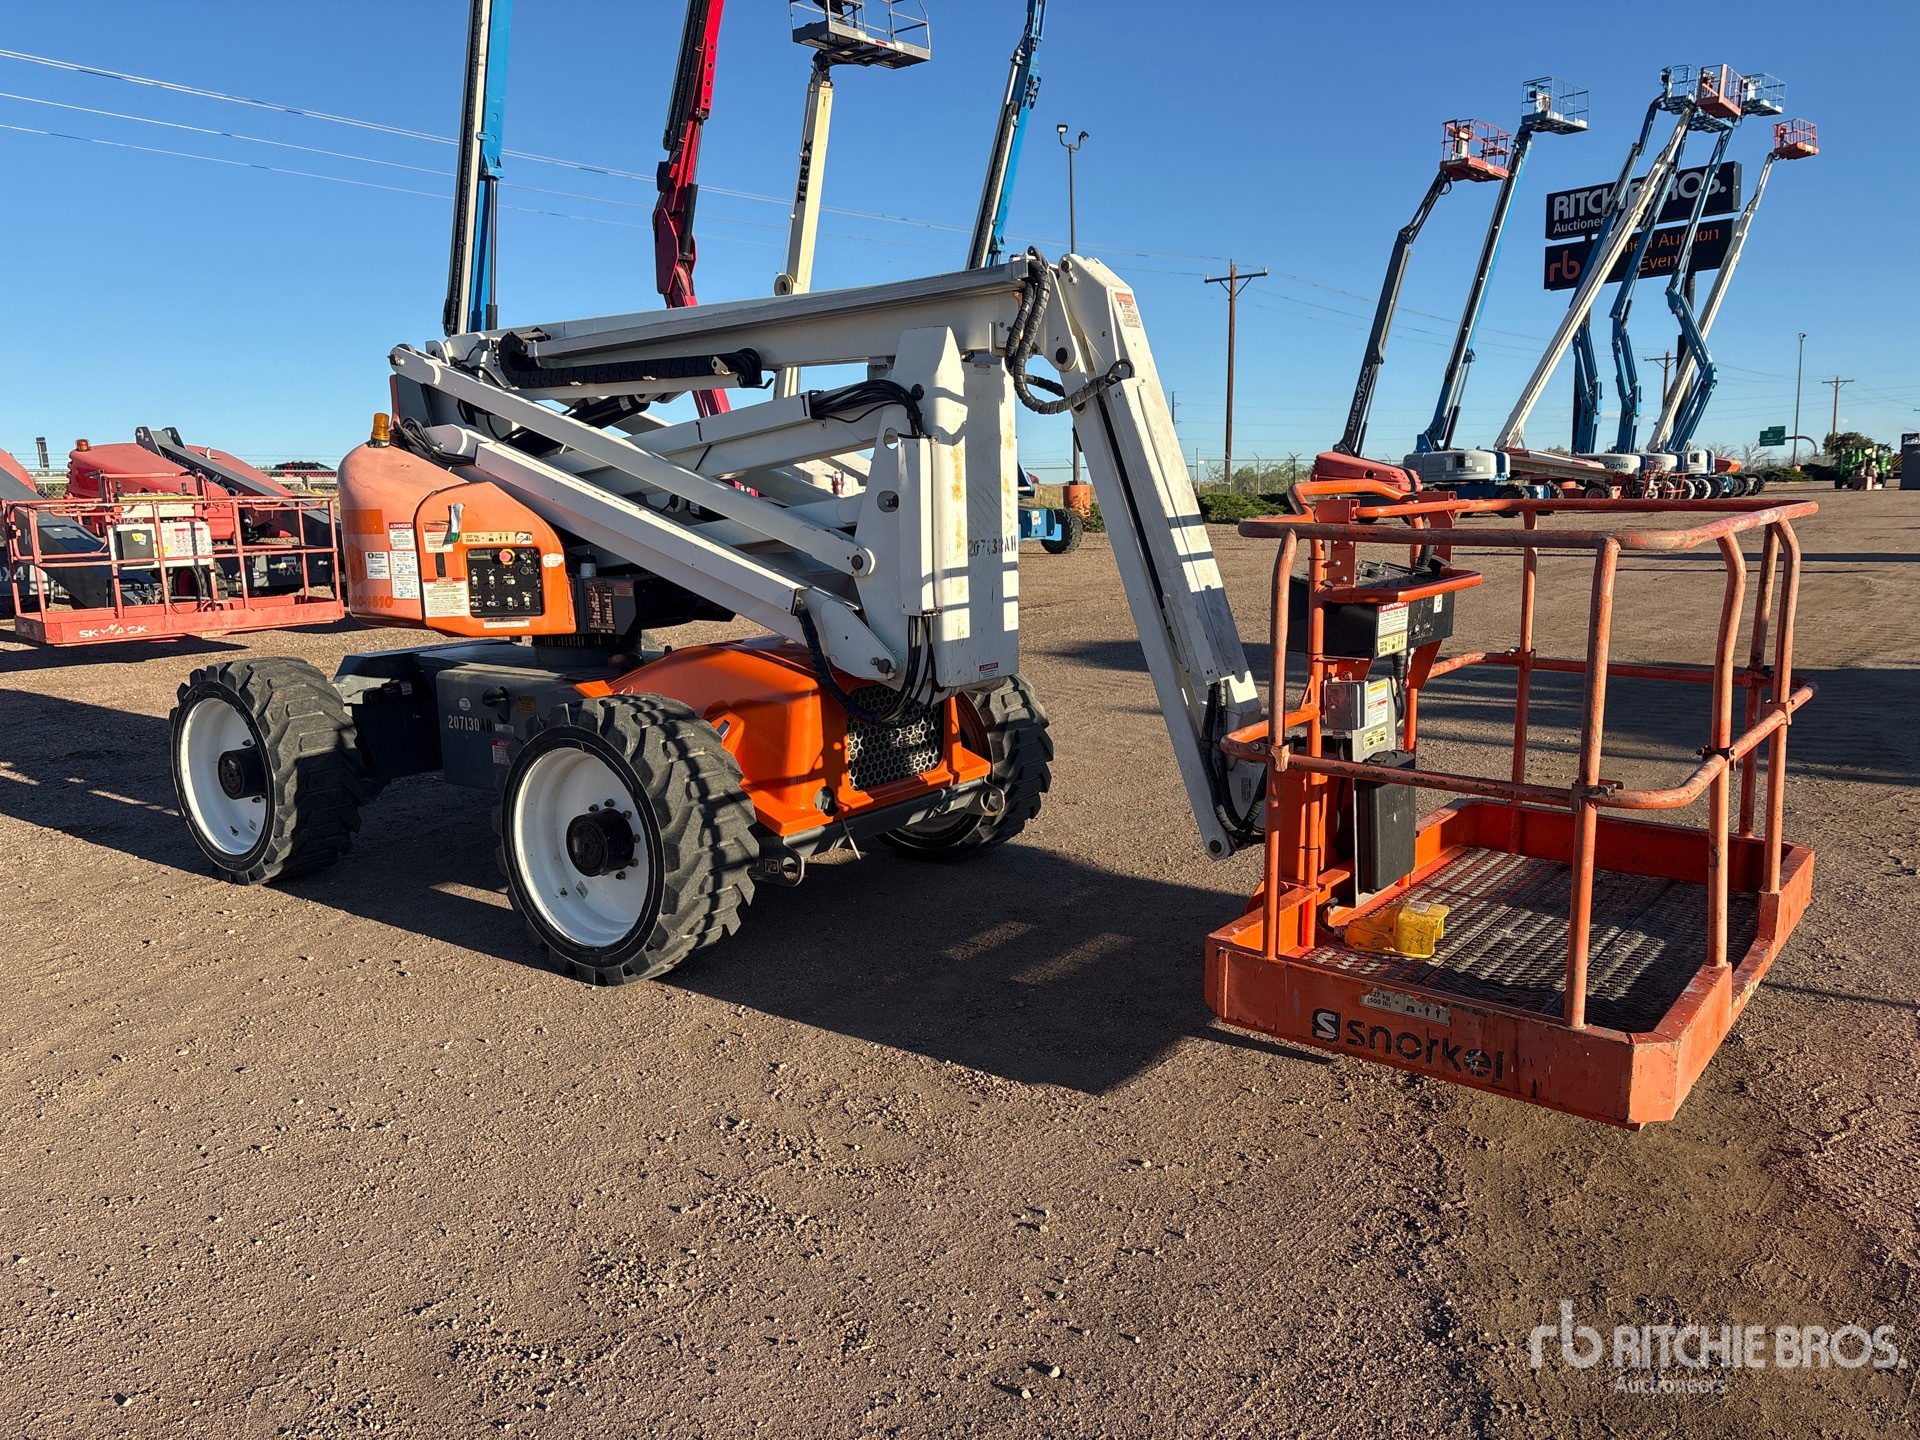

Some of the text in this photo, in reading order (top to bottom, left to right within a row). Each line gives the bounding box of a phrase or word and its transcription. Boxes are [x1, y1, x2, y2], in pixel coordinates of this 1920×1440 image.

[797, 140, 812, 203] TEREX
[1553, 217, 1605, 234] Auctione
[1549, 250, 1580, 282] rb
[1640, 255, 1678, 271] Even
[1354, 366, 1370, 411] SKYJACK
[0, 567, 26, 581] X4
[1346, 1019, 1504, 1080] snorkel
